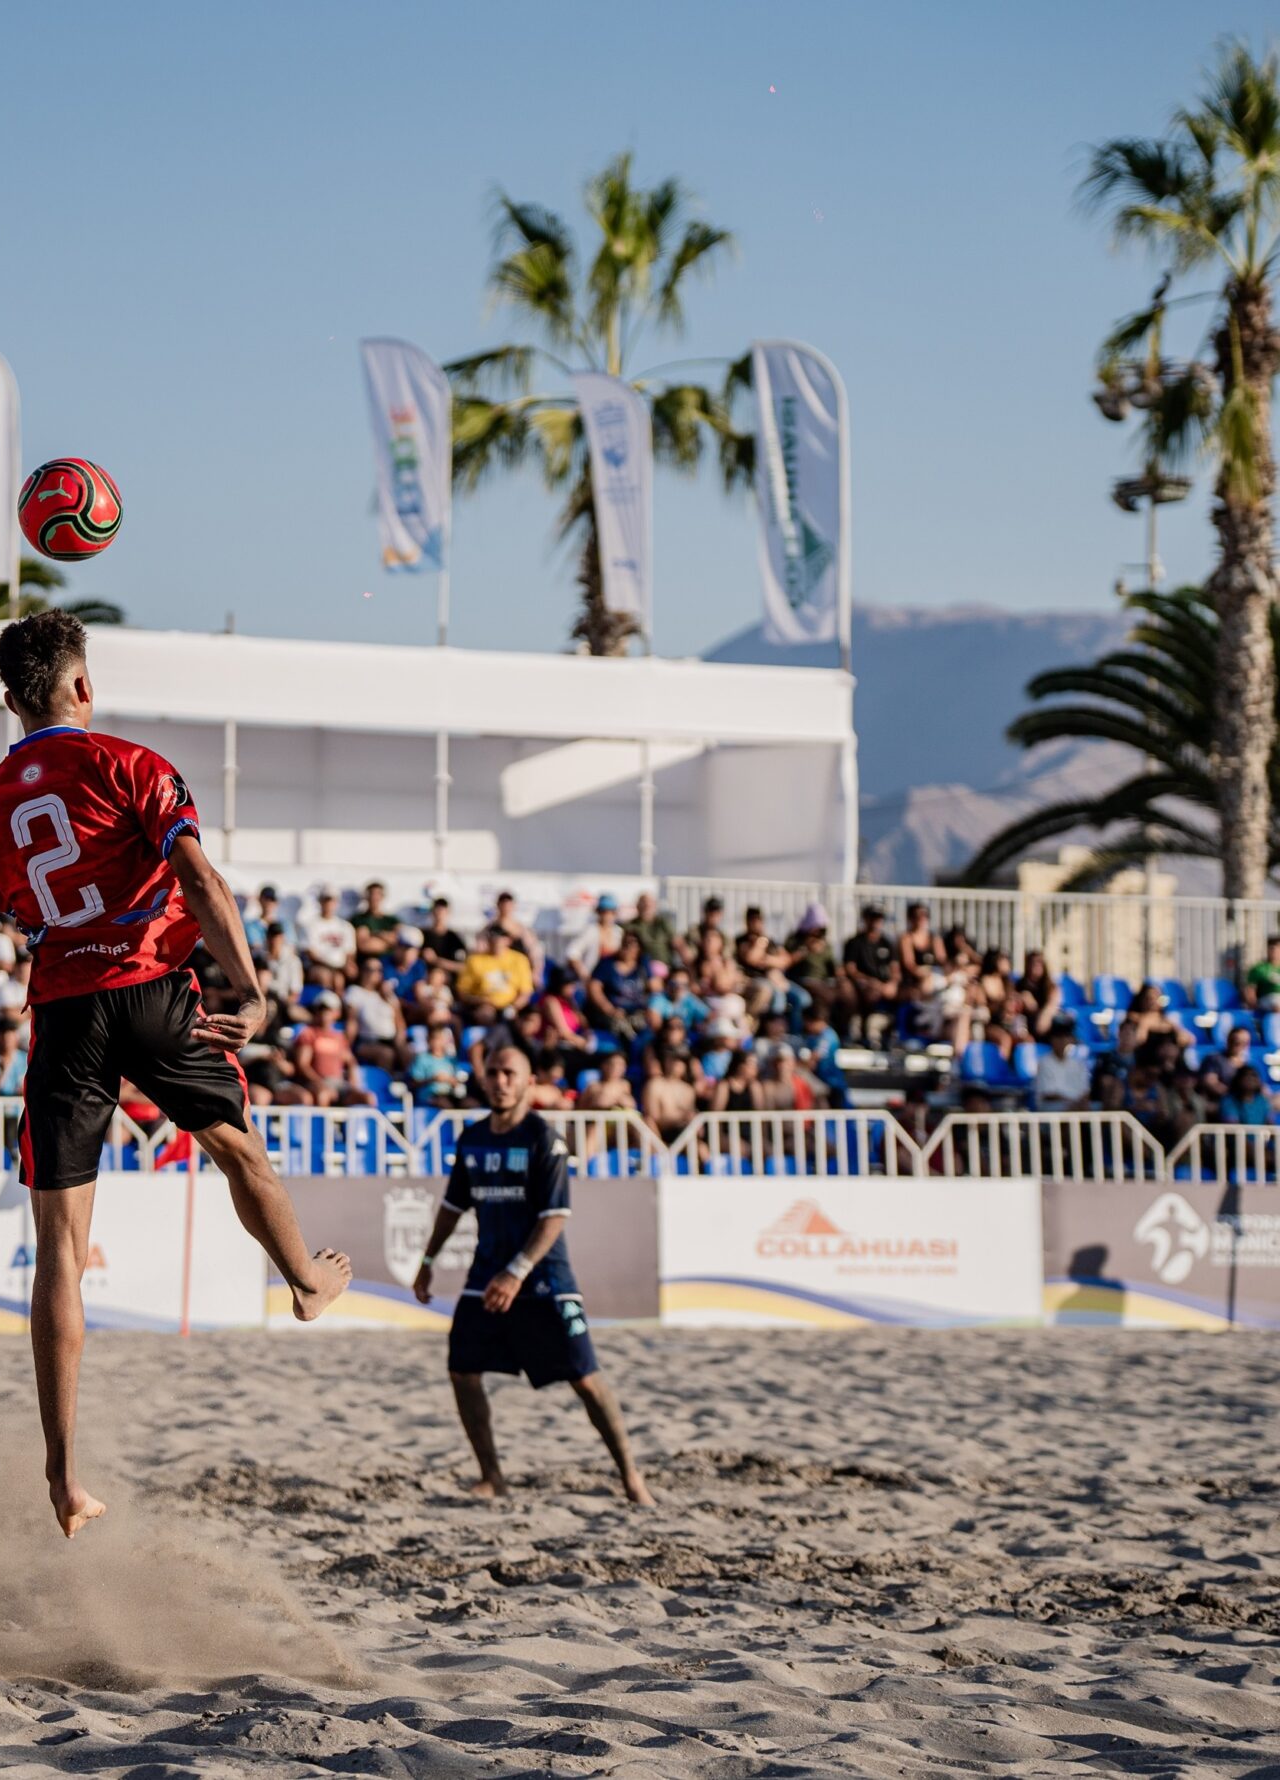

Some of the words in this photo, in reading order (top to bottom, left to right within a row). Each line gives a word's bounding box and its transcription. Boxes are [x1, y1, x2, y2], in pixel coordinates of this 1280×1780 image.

[10, 793, 106, 928] 2
[484, 1151, 502, 1173] 10
[756, 1237, 959, 1259] COLLAHUASI
